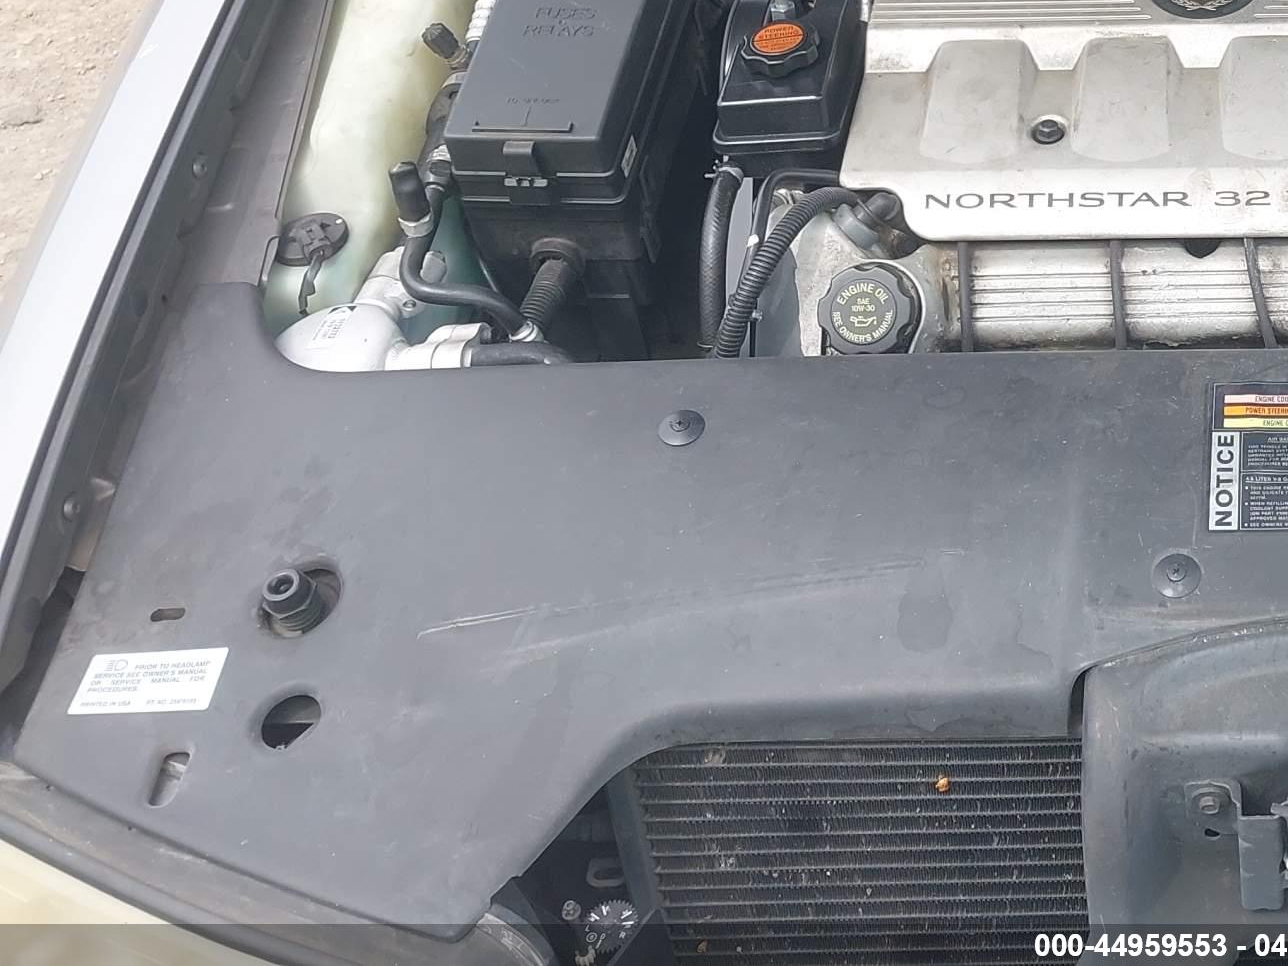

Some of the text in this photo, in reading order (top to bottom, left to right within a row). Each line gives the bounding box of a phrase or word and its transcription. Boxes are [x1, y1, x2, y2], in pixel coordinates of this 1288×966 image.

[522, 25, 594, 37] RELAYS
[924, 191, 1192, 210] NORTHSTAR
[1214, 190, 1272, 207] 32
[837, 282, 889, 305] ENGINE OIL
[857, 297, 870, 305] SAE
[875, 309, 893, 339] MANUAL
[1215, 434, 1235, 527] NOTICE
